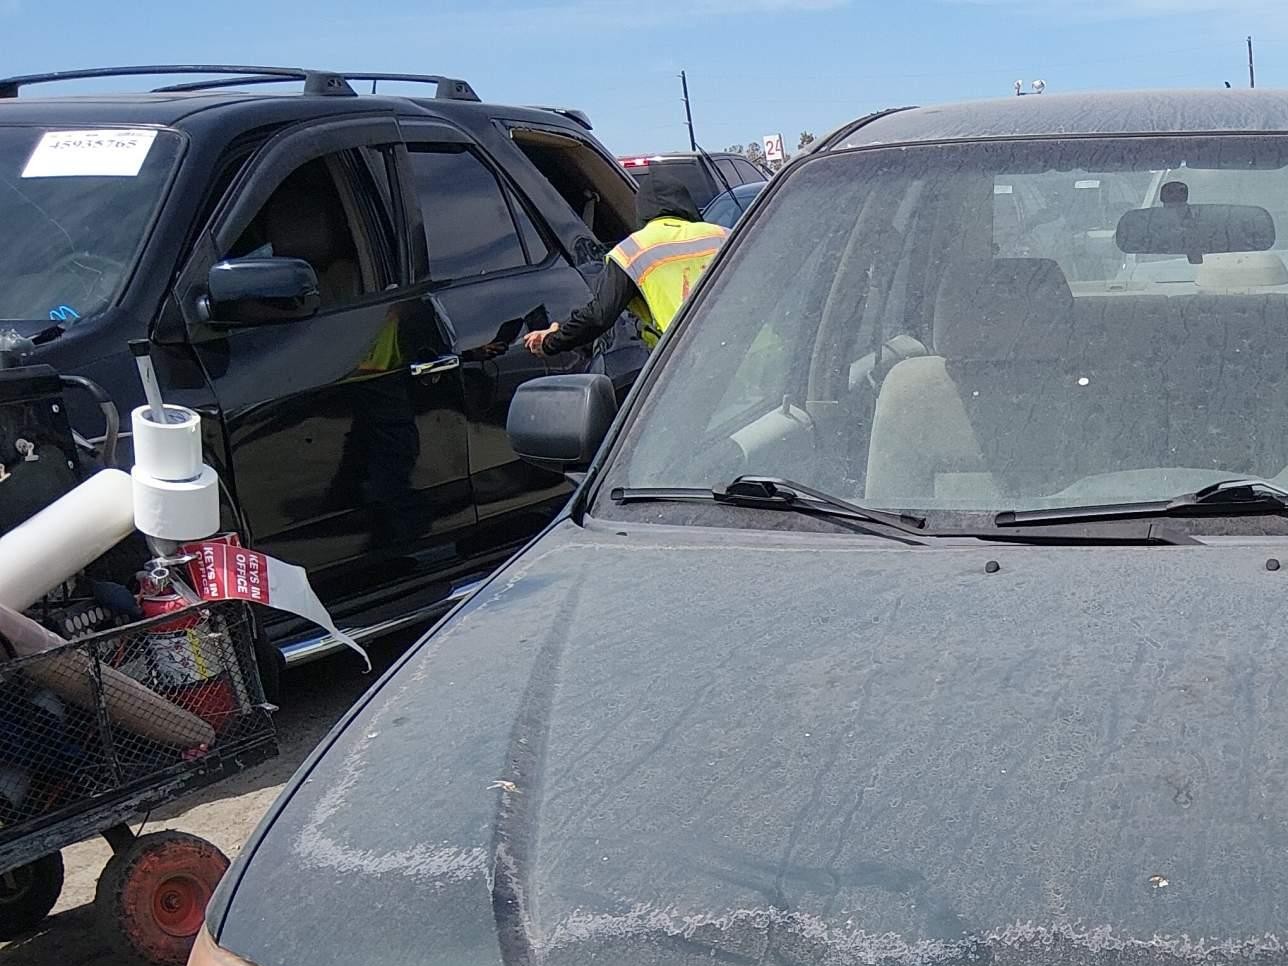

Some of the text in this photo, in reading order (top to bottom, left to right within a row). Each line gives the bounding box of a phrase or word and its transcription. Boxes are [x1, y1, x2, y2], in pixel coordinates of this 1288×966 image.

[766, 139, 782, 156] 24
[195, 550, 210, 595] OFFICE
[203, 546, 219, 597] KEYS IN
[235, 553, 248, 594] OFFICE
[248, 554, 261, 599] KEYS IN
